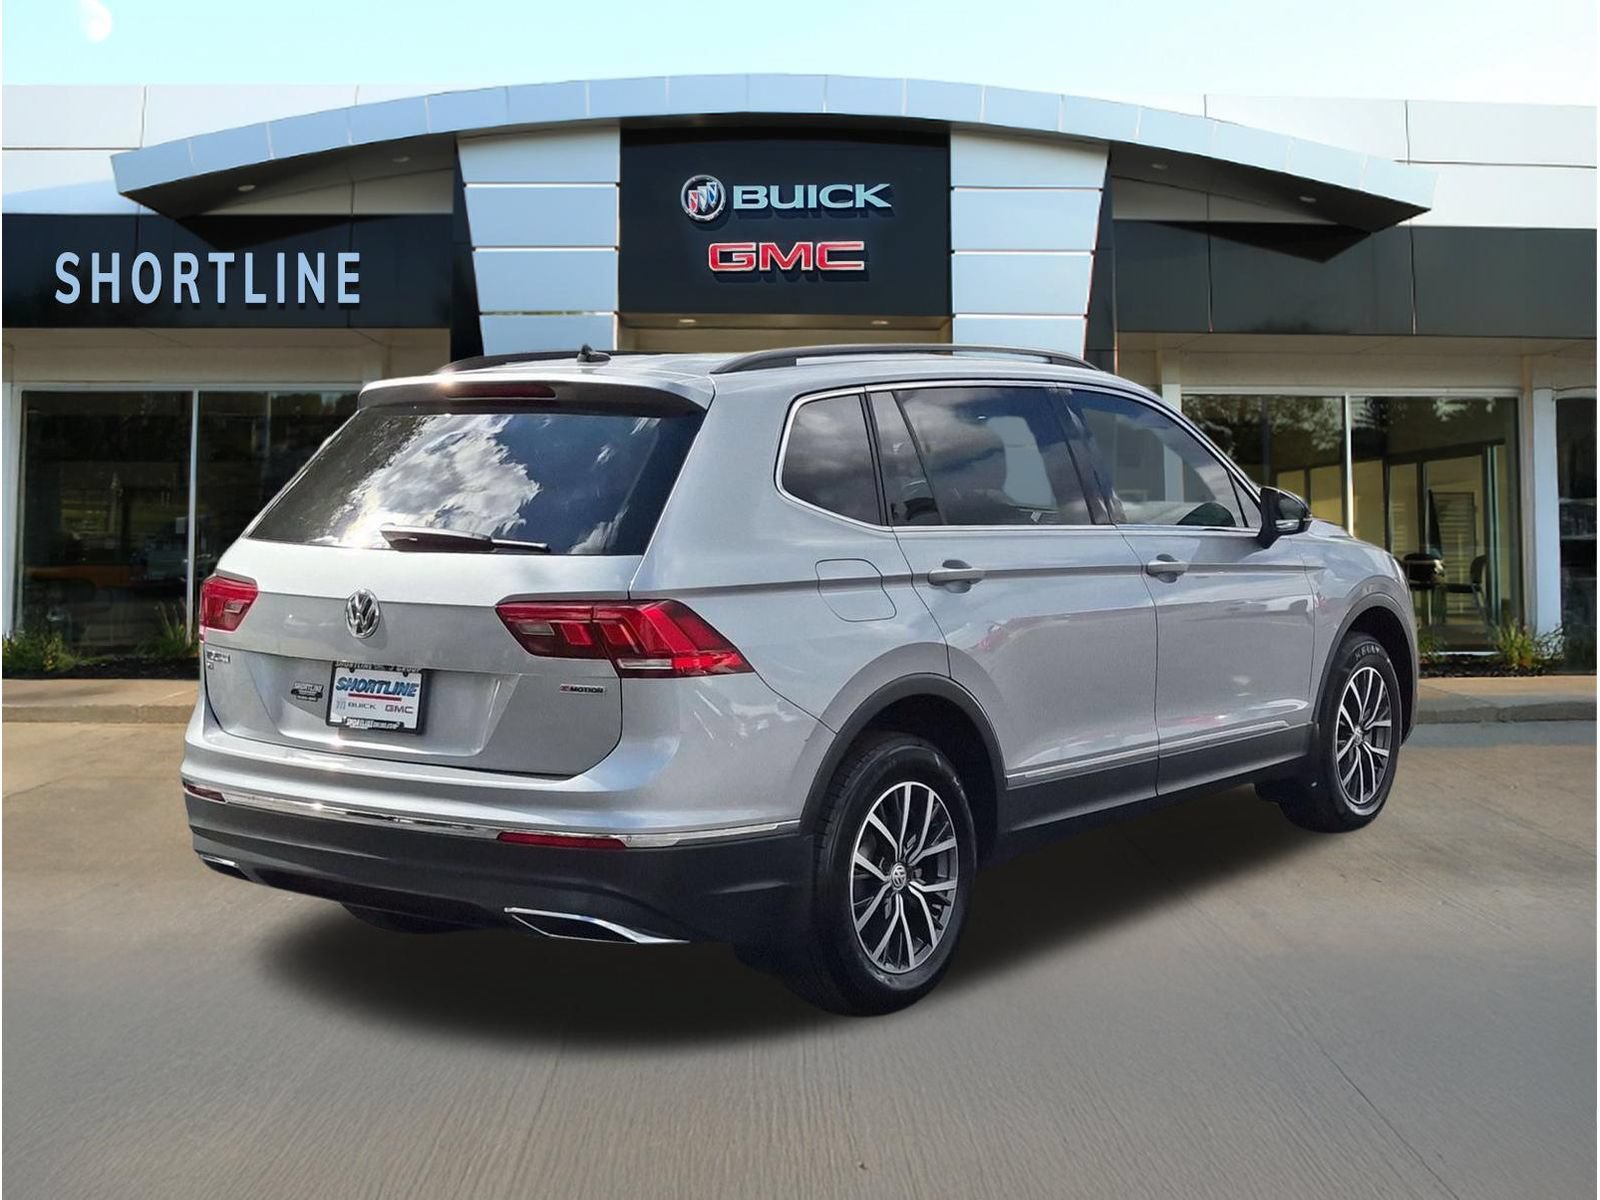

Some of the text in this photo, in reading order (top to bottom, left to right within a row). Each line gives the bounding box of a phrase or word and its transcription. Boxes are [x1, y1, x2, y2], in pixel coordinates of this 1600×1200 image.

[733, 183, 893, 210] BUICK
[708, 240, 865, 272] GMC
[54, 251, 361, 305] SHORTLINE
[335, 676, 420, 698] SHORTLINE
[347, 701, 415, 715] BUICK GMC
